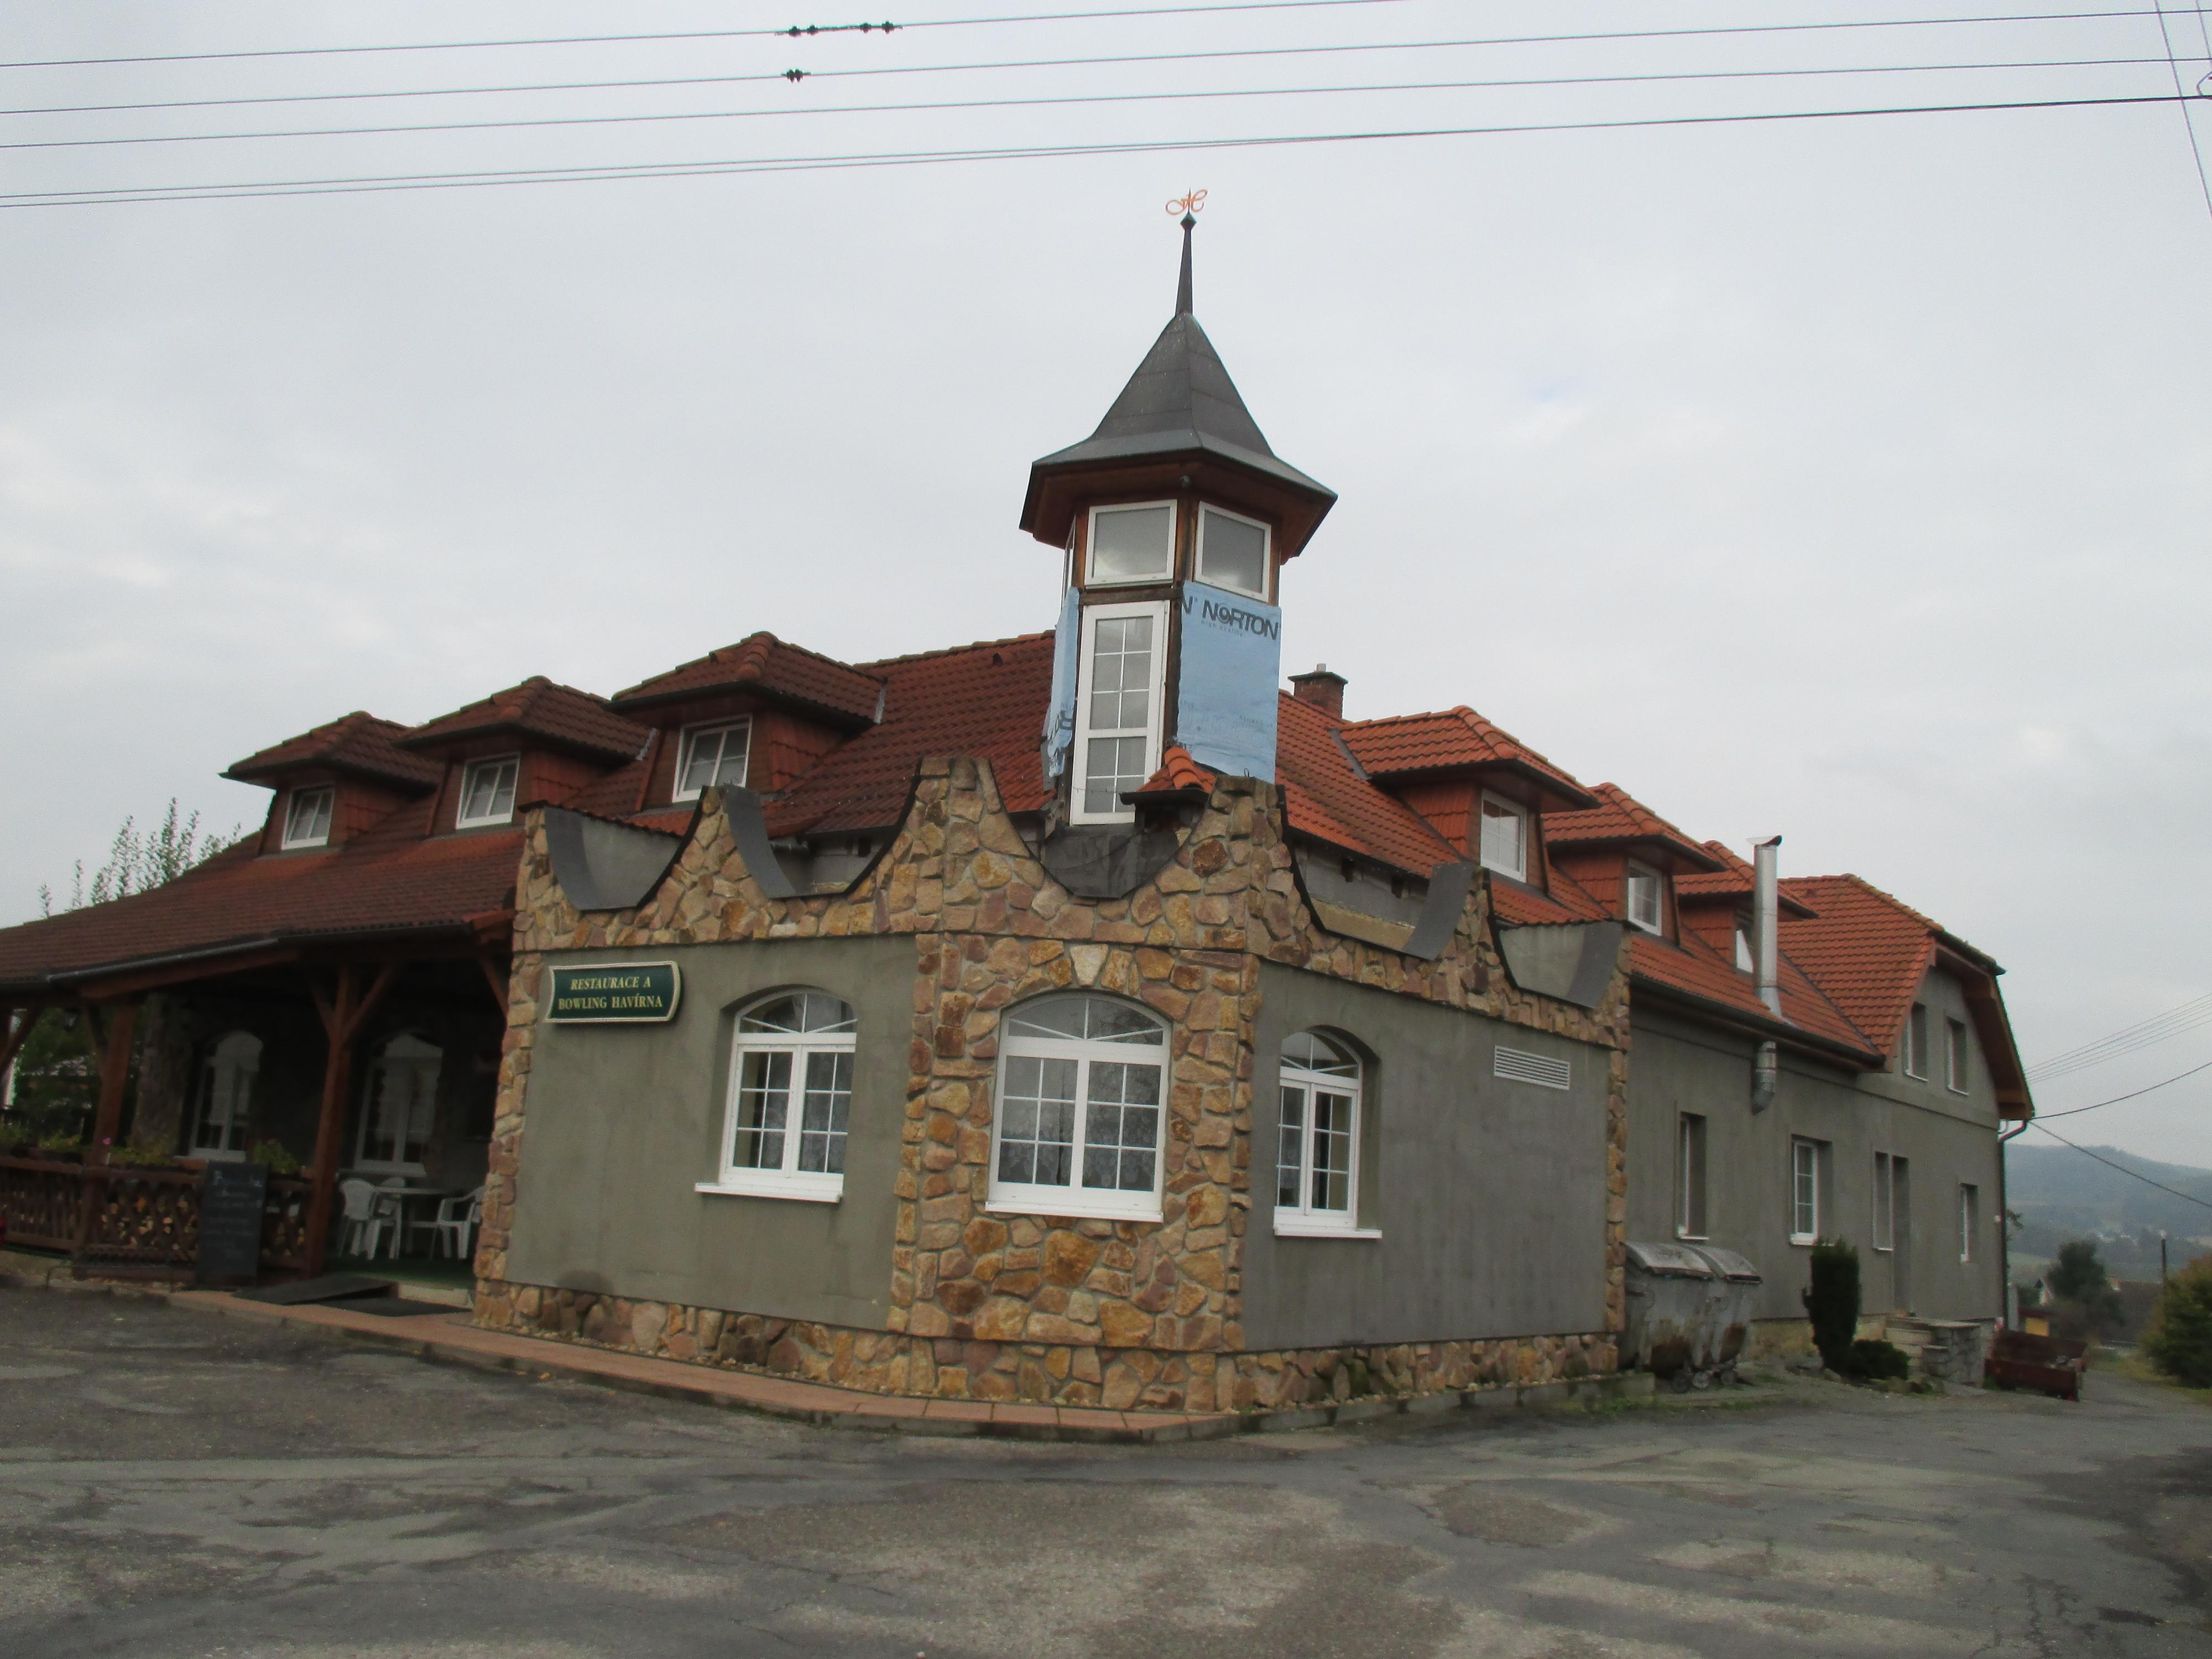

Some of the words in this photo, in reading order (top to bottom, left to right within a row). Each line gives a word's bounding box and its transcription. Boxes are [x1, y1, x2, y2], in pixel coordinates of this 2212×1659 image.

[1202, 599, 1279, 640] NORTON
[571, 977, 639, 990] RESTAURACE
[644, 977, 650, 987] A
[559, 997, 607, 1009] BOWLING
[612, 993, 662, 1008] HAVÍRNA
